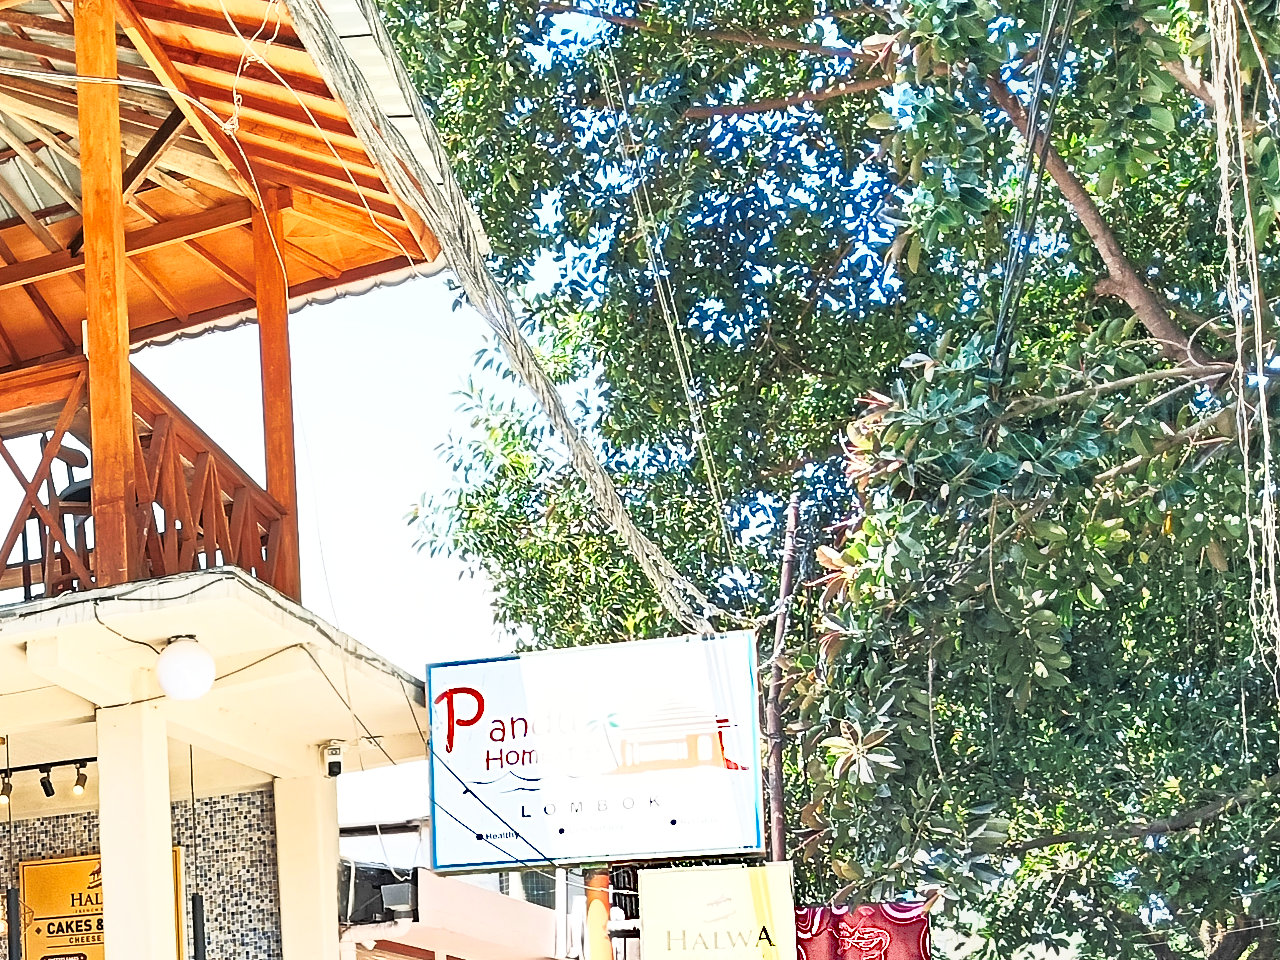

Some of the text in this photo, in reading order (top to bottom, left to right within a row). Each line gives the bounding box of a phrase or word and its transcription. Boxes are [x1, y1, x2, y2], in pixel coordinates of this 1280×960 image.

[521, 796, 660, 818] LOMBOK
[71, 892, 103, 907] HAL
[47, 919, 93, 935] CAKES
[69, 935, 102, 944] CHEESE
[666, 925, 776, 952] HALWA
